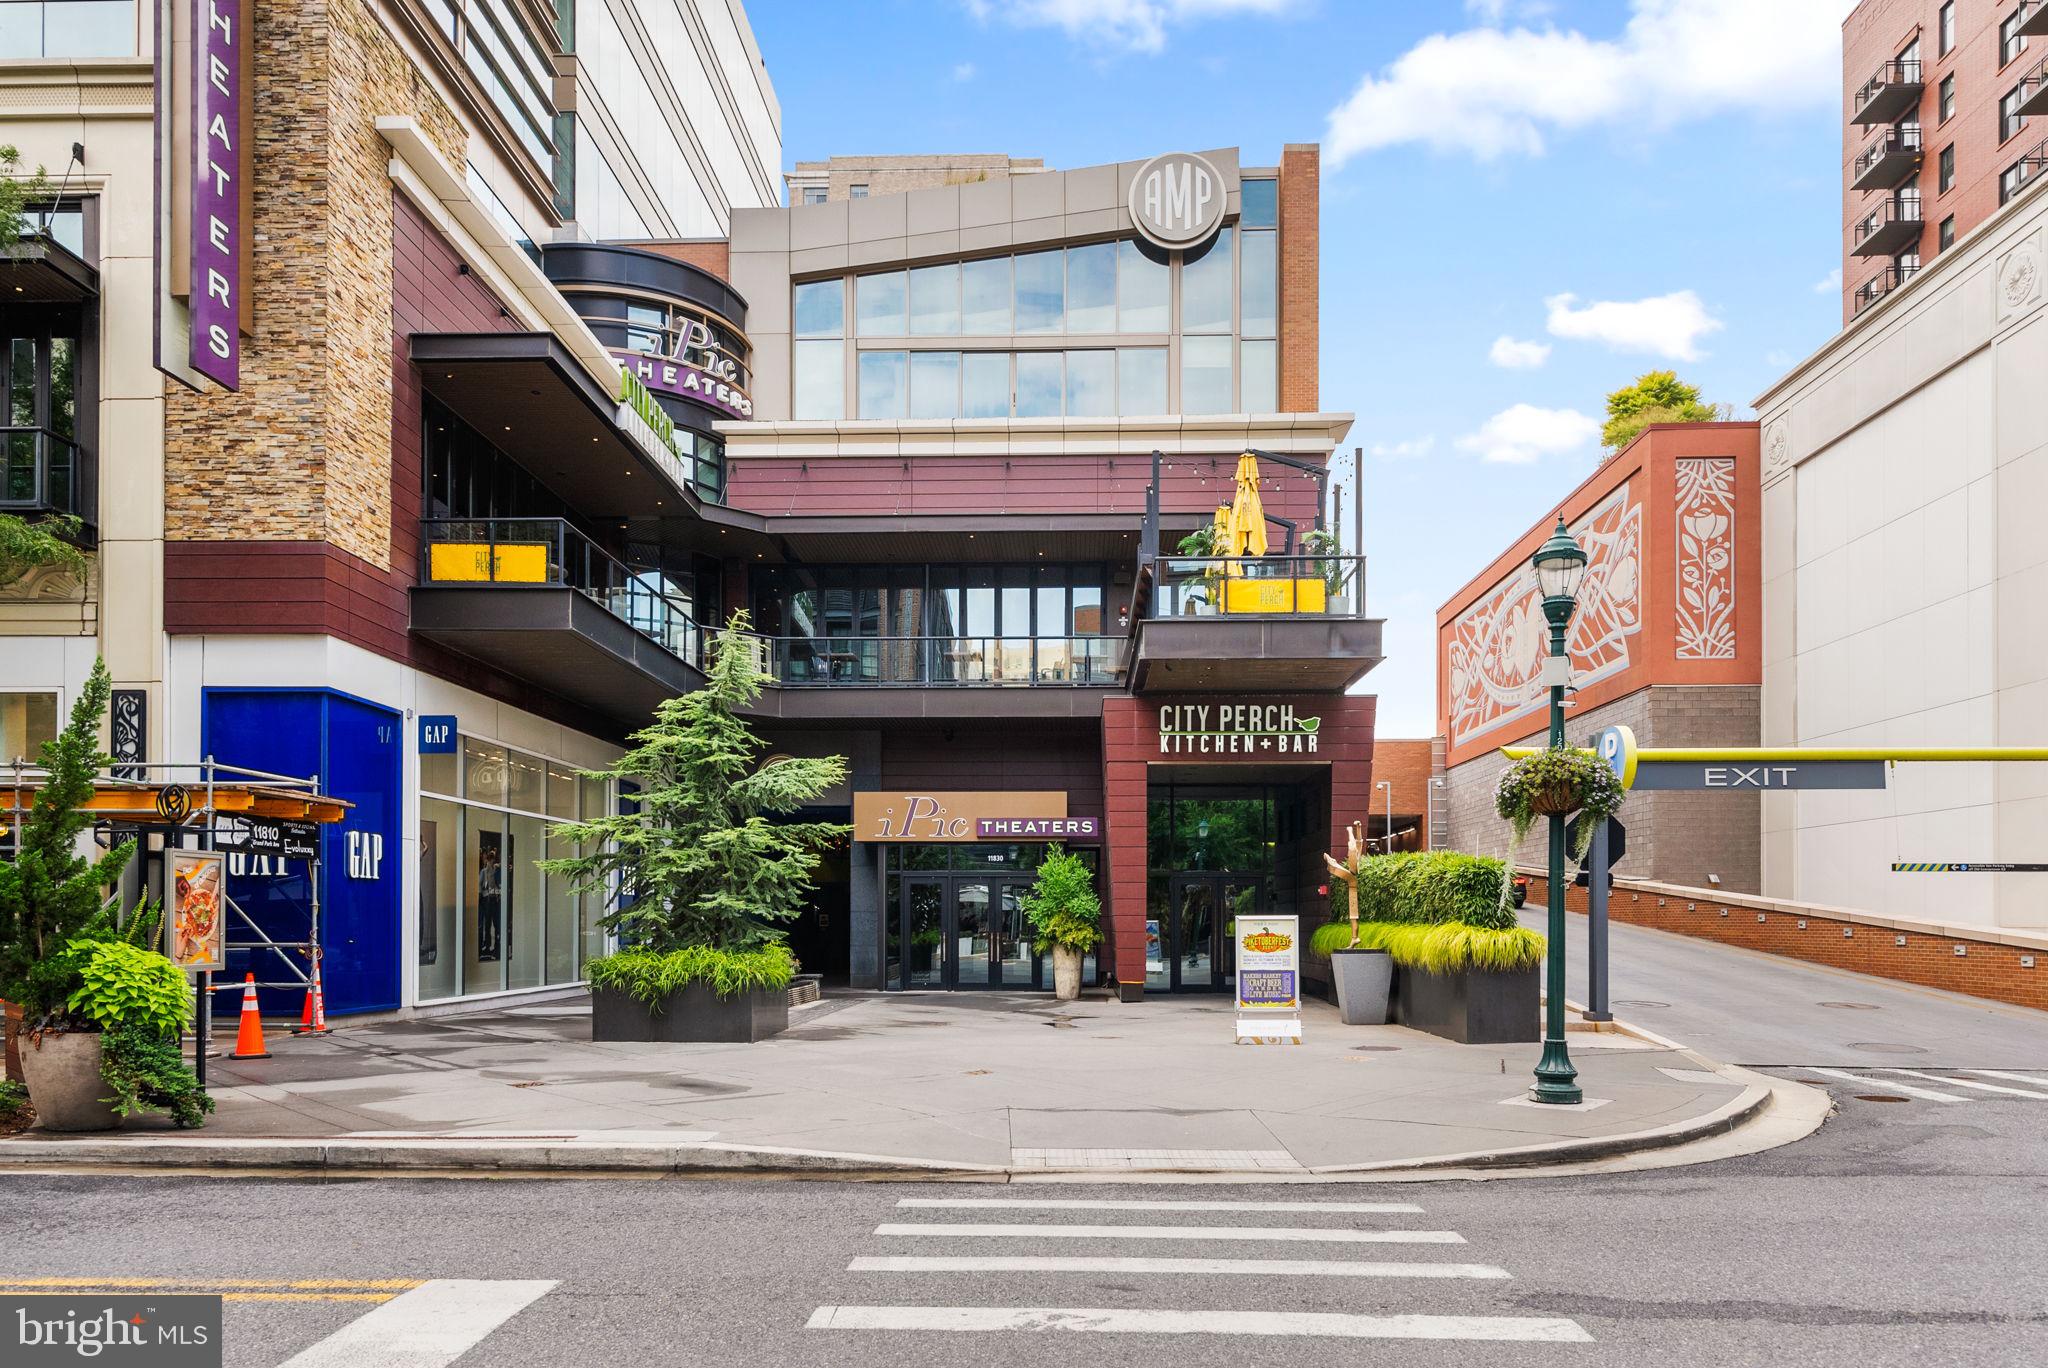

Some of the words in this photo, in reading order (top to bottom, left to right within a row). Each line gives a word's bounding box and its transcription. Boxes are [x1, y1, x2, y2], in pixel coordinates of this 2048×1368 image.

[1145, 162, 1211, 231] AMP
[643, 316, 737, 382] iPic
[475, 562, 501, 573] PERH
[1160, 705, 1209, 732] CITY
[1220, 705, 1293, 732] PERCH
[425, 725, 448, 743] GAP
[1160, 736, 1254, 753] KITCHEN
[1278, 735, 1318, 753] BAR
[1604, 732, 1618, 760] P
[1704, 767, 1797, 786] EXIT
[875, 796, 969, 838] iPic
[981, 820, 1094, 833] THEATERS
[253, 825, 279, 841] 11810
[350, 830, 383, 880] GAP
[1249, 978, 1266, 987] CRAFT
[1267, 978, 1282, 987] BEER
